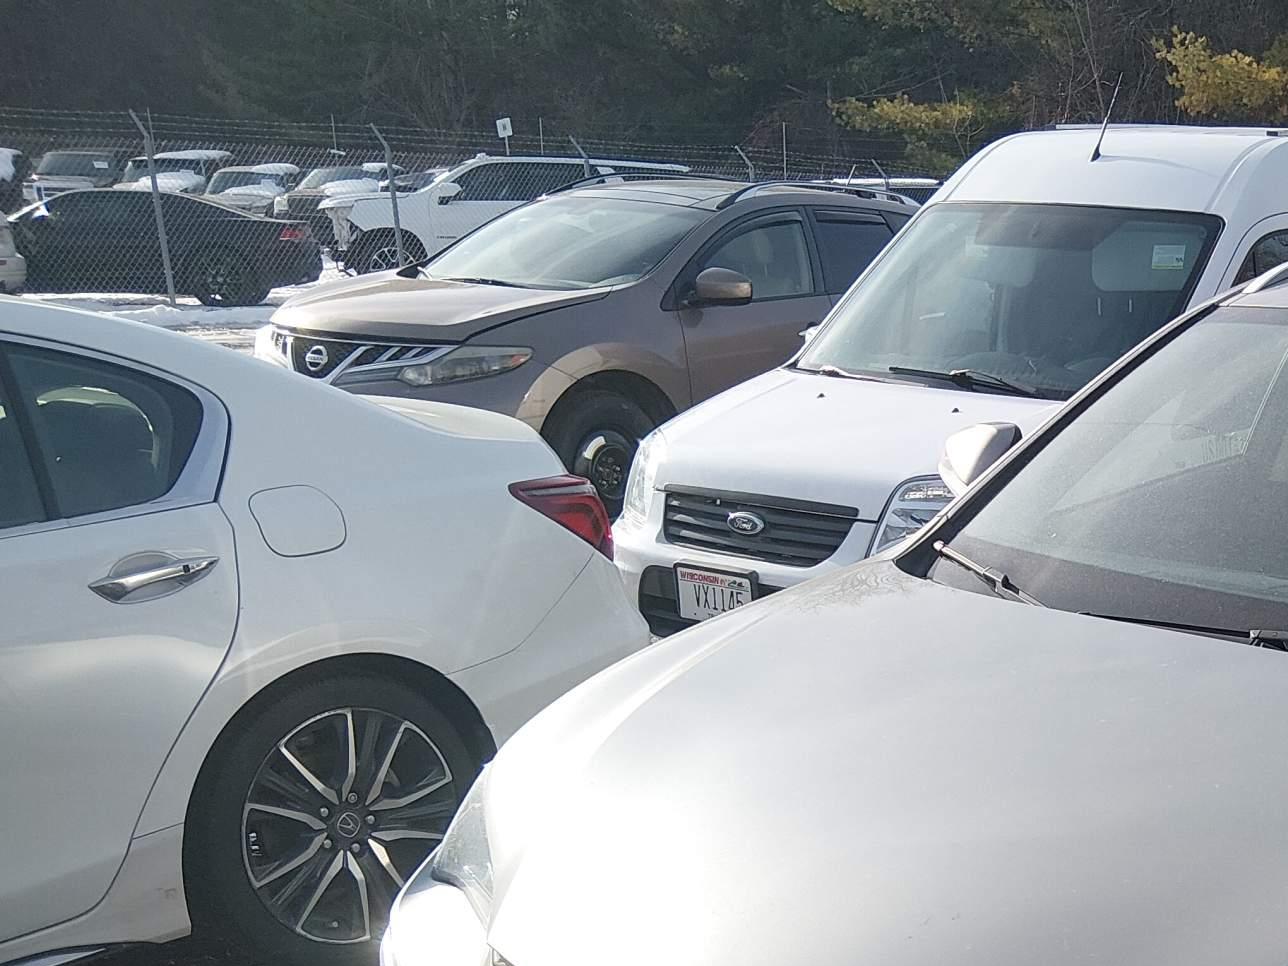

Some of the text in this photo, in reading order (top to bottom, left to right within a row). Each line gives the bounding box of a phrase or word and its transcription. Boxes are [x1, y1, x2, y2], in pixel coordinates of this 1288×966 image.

[733, 517, 753, 531] Ford
[680, 570, 720, 585] WISCONSIN
[693, 583, 744, 613] VX1145
